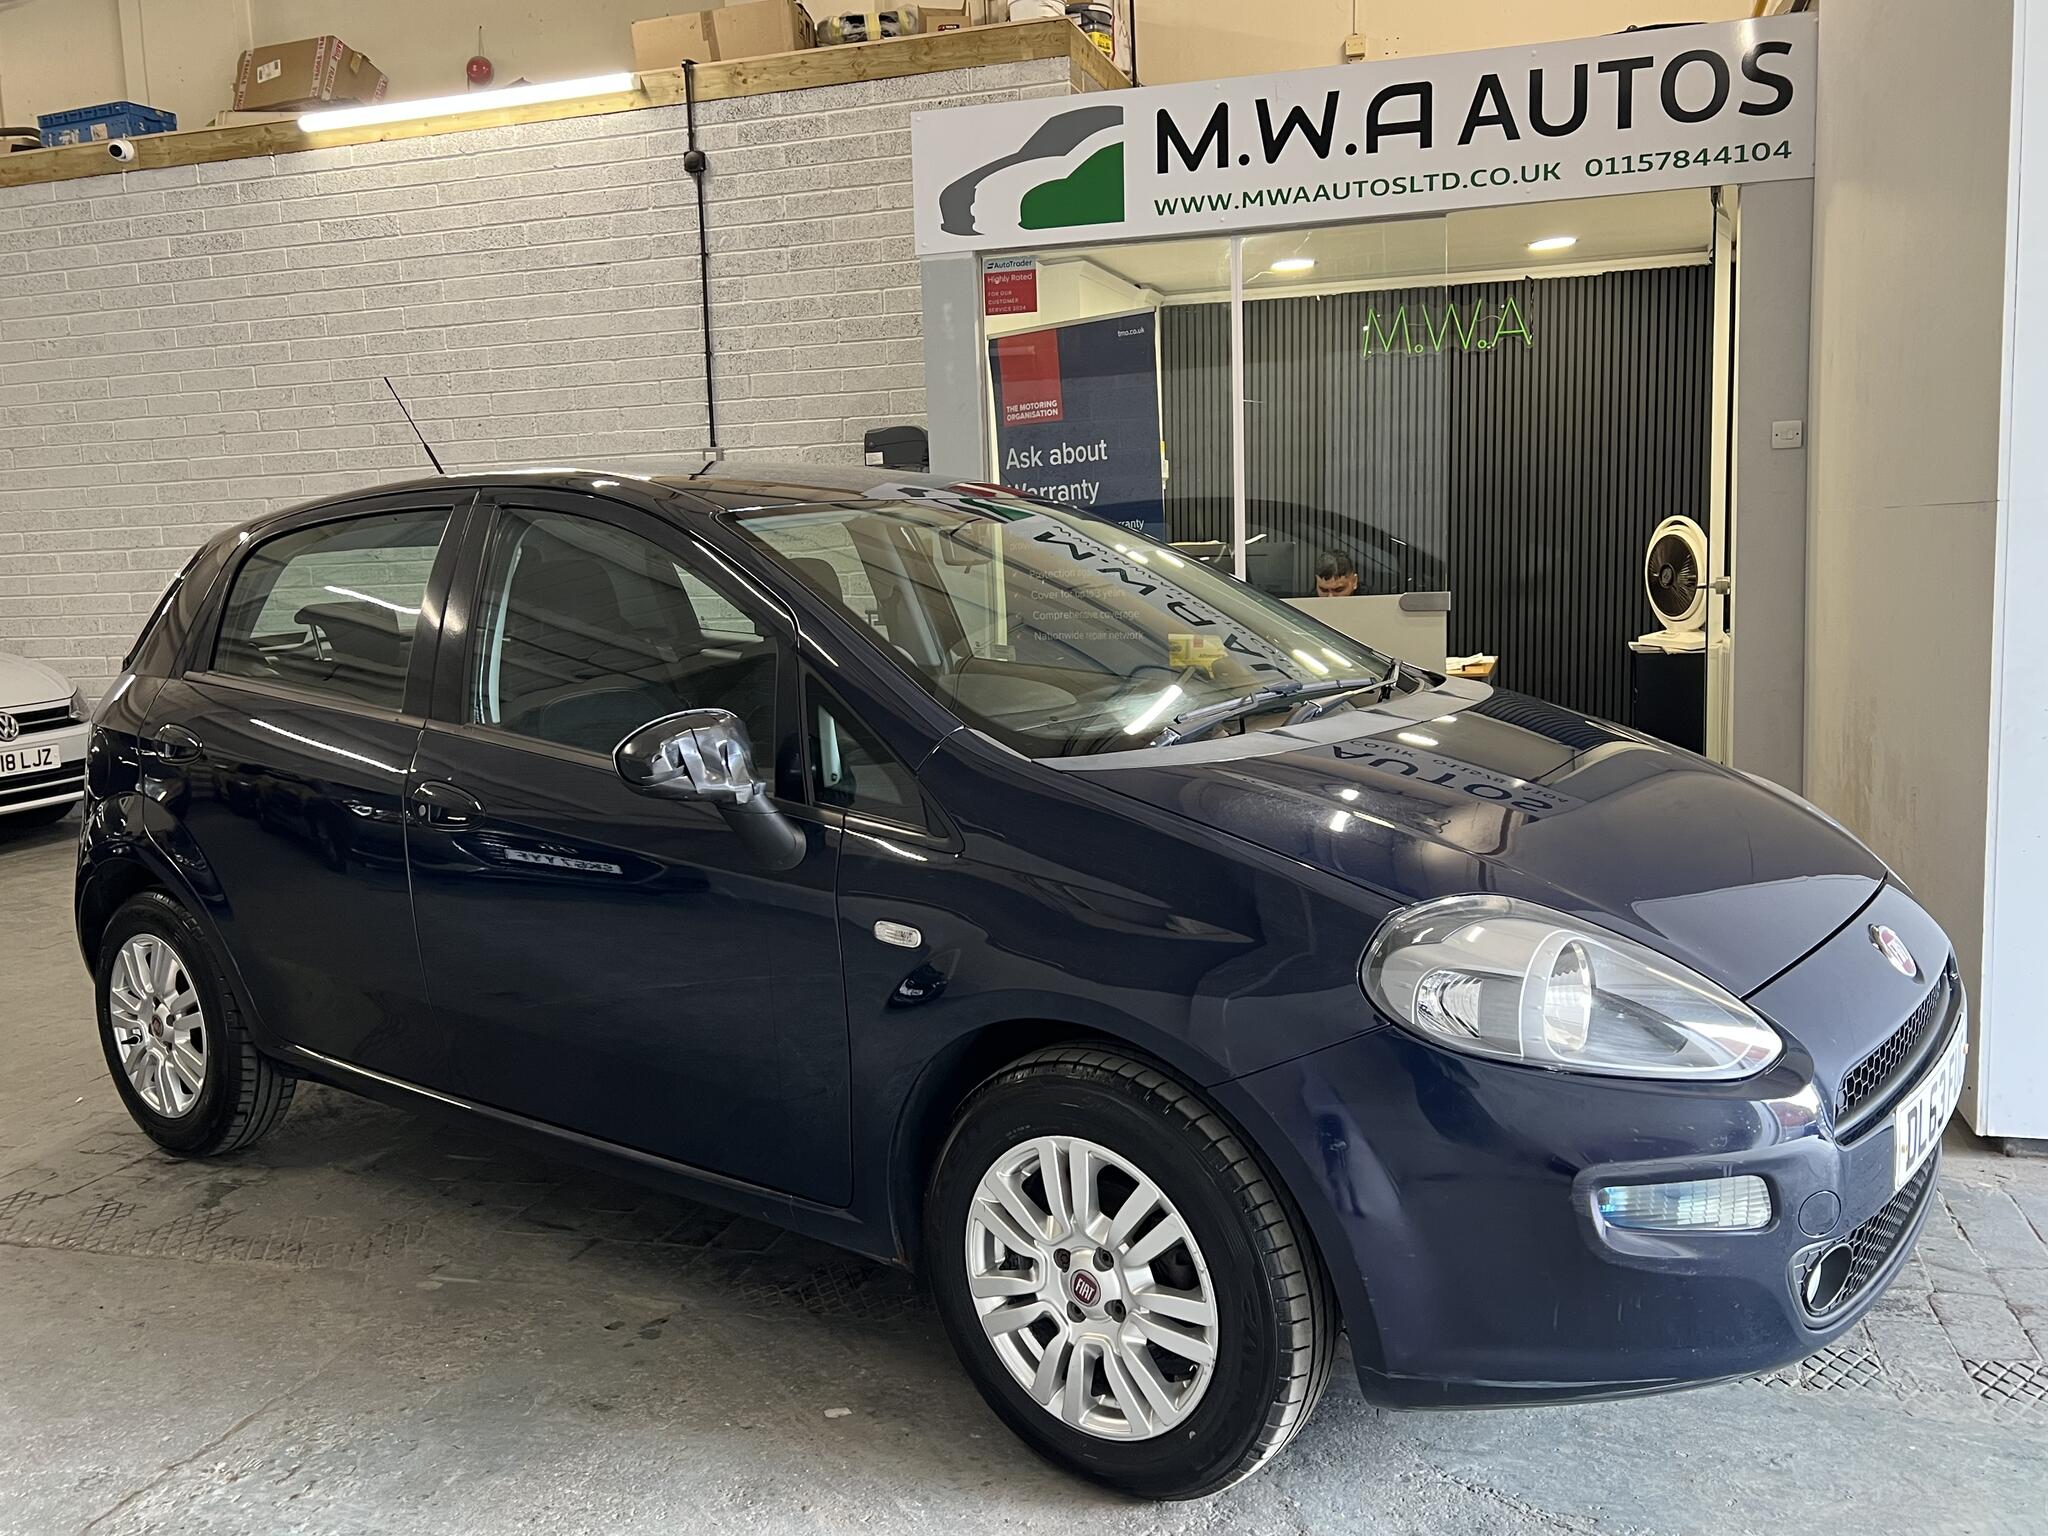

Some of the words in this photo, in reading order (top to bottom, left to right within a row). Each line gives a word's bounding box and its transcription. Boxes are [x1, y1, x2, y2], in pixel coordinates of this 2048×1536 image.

[1156, 81, 1433, 174] M.W.A
[1457, 41, 1795, 146] AUTOS
[1154, 162, 1561, 216] WWW.MWAAUTOSLTD.CO.UK
[1585, 140, 1793, 177] 01157844104
[993, 259, 1033, 269] AutoTrader
[987, 274, 1010, 284] Highly
[1010, 272, 1033, 281] Rated
[1362, 296, 1532, 358] M.W.A
[1006, 405, 1018, 413] THE
[1019, 400, 1057, 412] MOTORING
[1006, 408, 1059, 421] ORGANISATION
[1006, 446, 1043, 469] Ask
[1049, 439, 1108, 464] about
[20, 748, 53, 769] LJZ
[1905, 1067, 1946, 1172] DL63
[1075, 1278, 1095, 1301] FIAT
